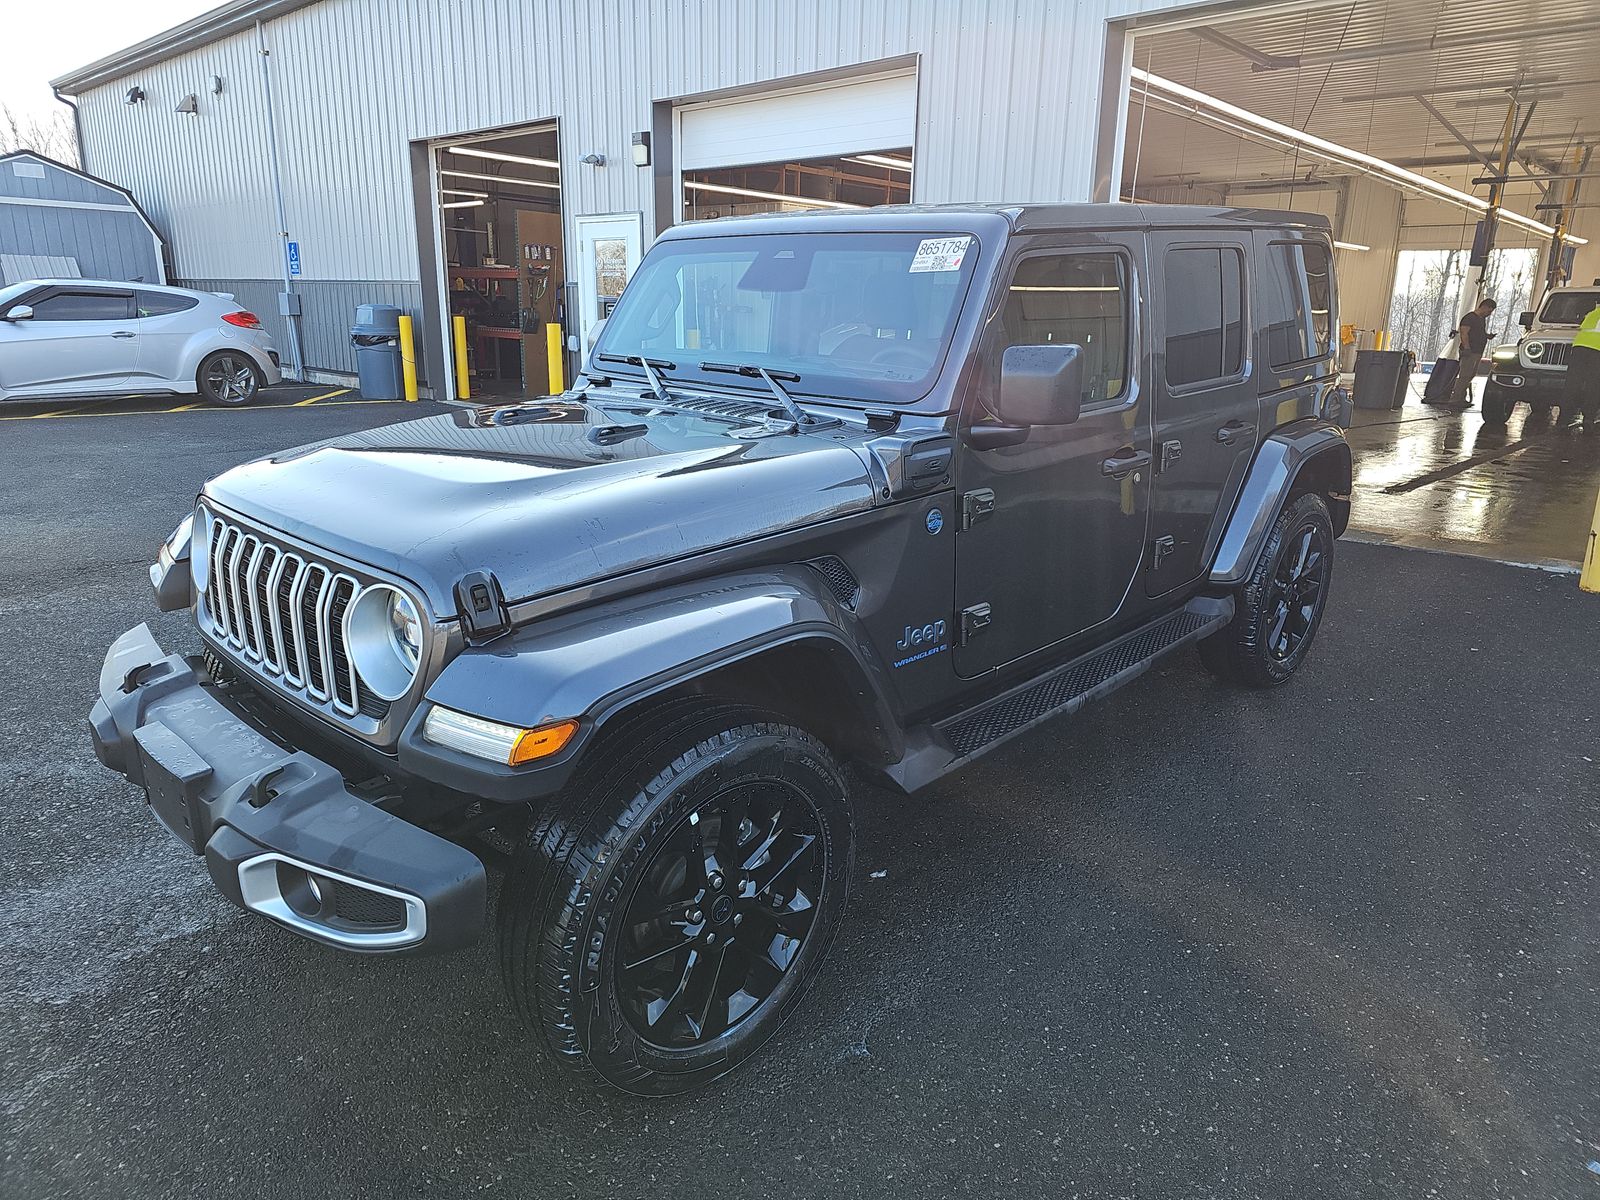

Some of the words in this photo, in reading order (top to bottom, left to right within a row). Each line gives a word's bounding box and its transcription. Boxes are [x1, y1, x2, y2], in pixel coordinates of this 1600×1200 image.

[919, 241, 967, 255] 8651784
[896, 620, 947, 650] Jeep
[893, 647, 940, 668] WRANGLER
